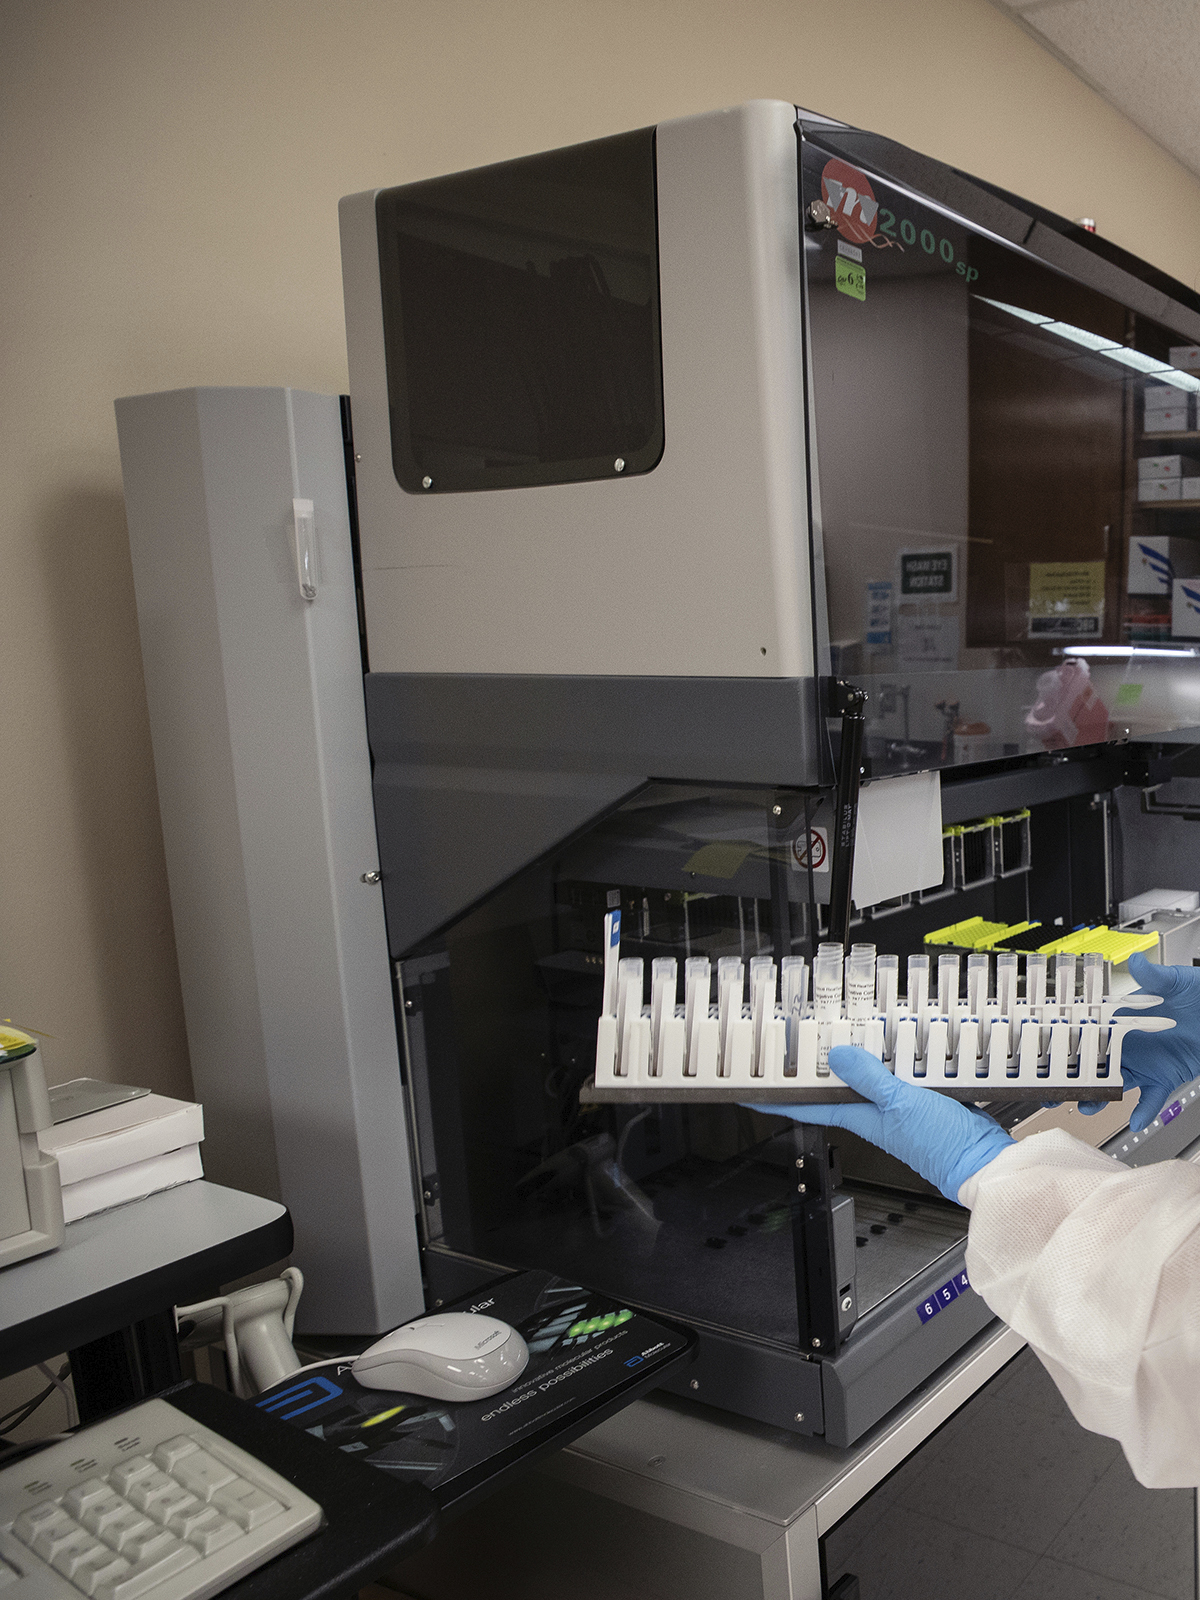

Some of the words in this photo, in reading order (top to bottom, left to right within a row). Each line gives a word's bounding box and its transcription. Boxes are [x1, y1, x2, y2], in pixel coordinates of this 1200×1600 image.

[924, 1302, 934, 1316] 6
[942, 1288, 952, 1301] 5
[961, 1274, 969, 1286] 4
[474, 1330, 502, 1351] Microsoft
[511, 1368, 554, 1394] innovative
[554, 1349, 593, 1371] molecular
[593, 1329, 628, 1351] products
[481, 1388, 538, 1423] endless
[538, 1347, 614, 1392] possibilities
